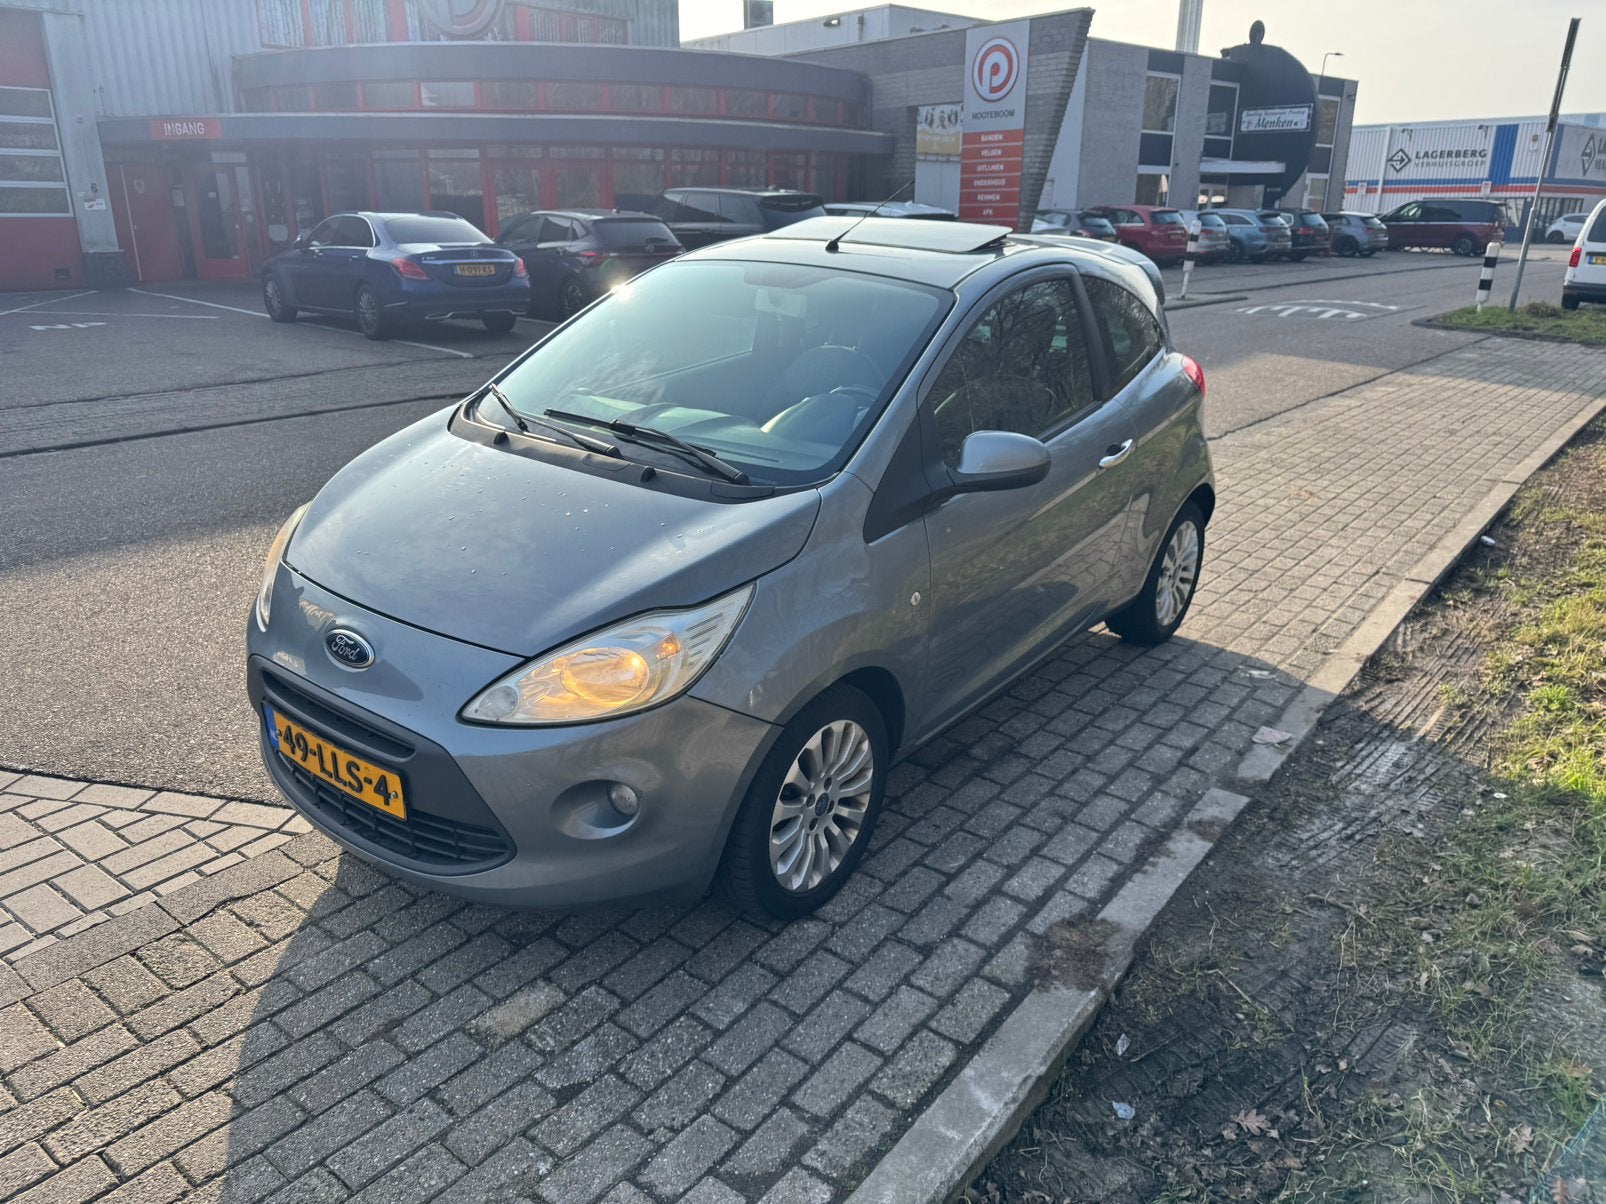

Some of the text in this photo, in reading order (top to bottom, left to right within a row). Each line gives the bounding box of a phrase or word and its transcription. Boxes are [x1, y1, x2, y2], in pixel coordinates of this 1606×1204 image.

[971, 108, 1015, 121] NOOTEBOOM
[1254, 116, 1293, 128] Menken
[163, 122, 205, 136] INGANG
[1415, 149, 1487, 160] LAGERBERG
[1414, 159, 1486, 168] VERHUISGROEP
[90, 182, 98, 193] 6
[331, 634, 361, 660] Ford
[282, 724, 391, 807] 49-LLS-4
